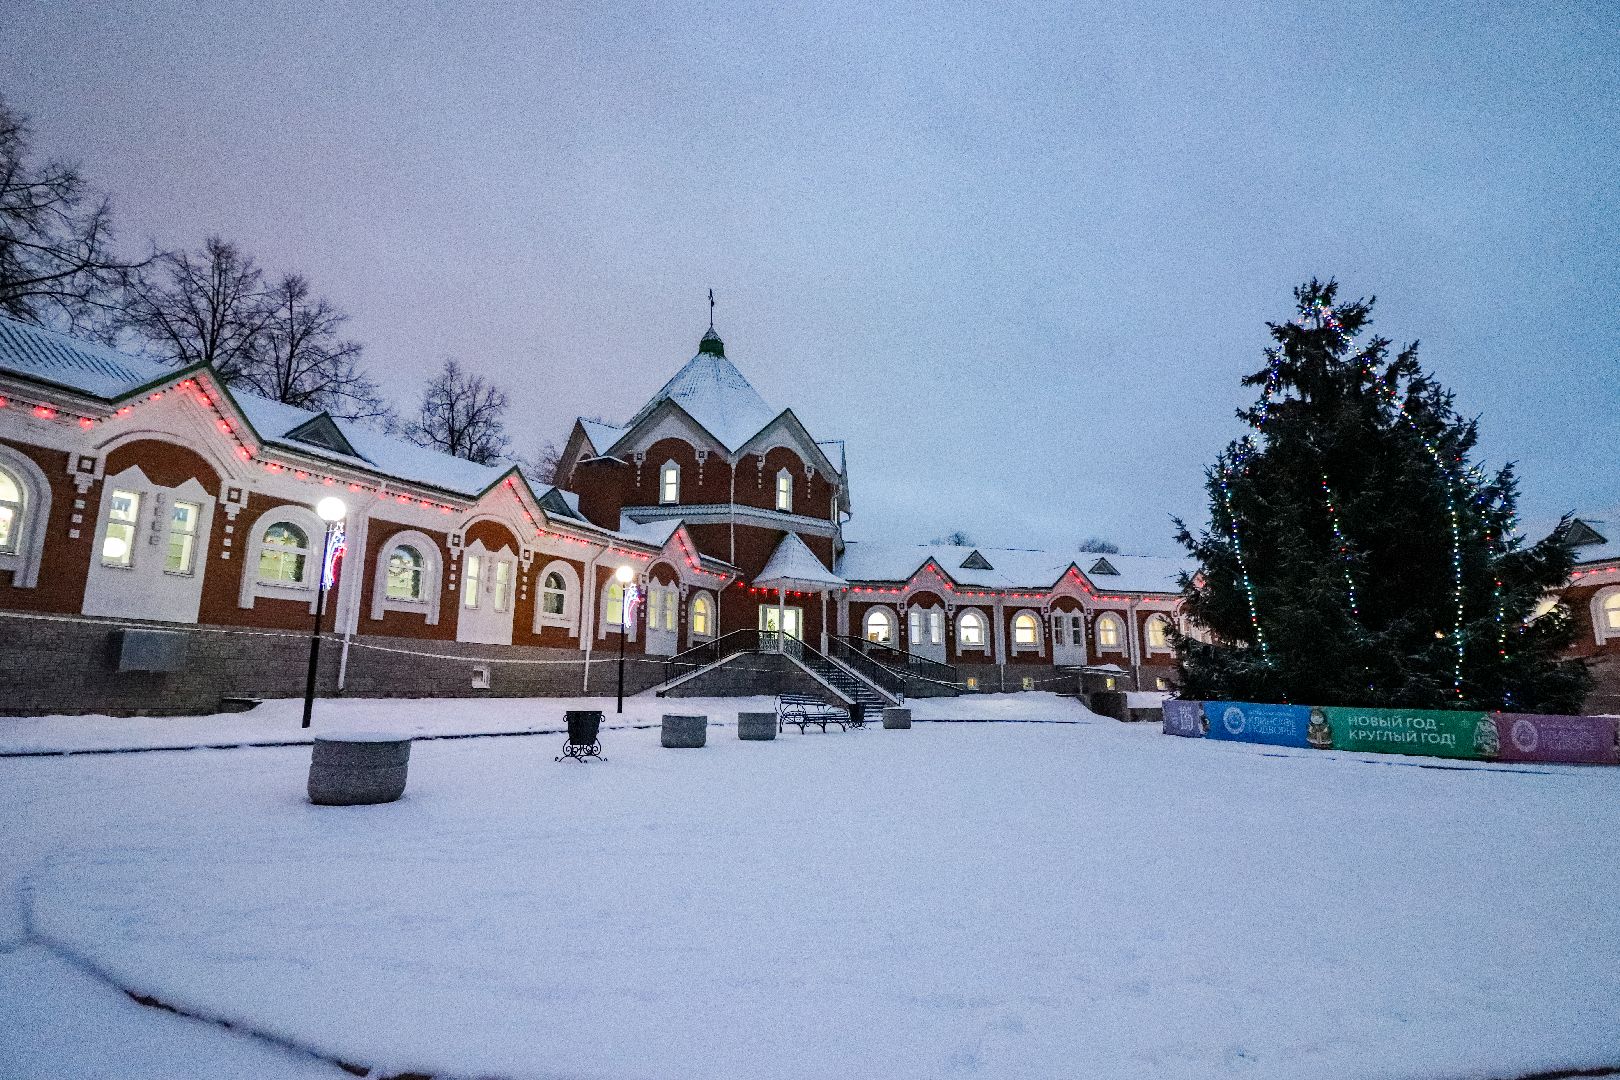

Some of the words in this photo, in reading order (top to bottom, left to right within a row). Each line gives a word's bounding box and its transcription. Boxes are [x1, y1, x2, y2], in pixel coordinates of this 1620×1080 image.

[1348, 714, 1402, 728] НОВЫЙ
[1406, 718, 1438, 731] ГОД
[1349, 729, 1418, 742] КРУГЛЫЙ
[1421, 733, 1456, 748] ГОД!
